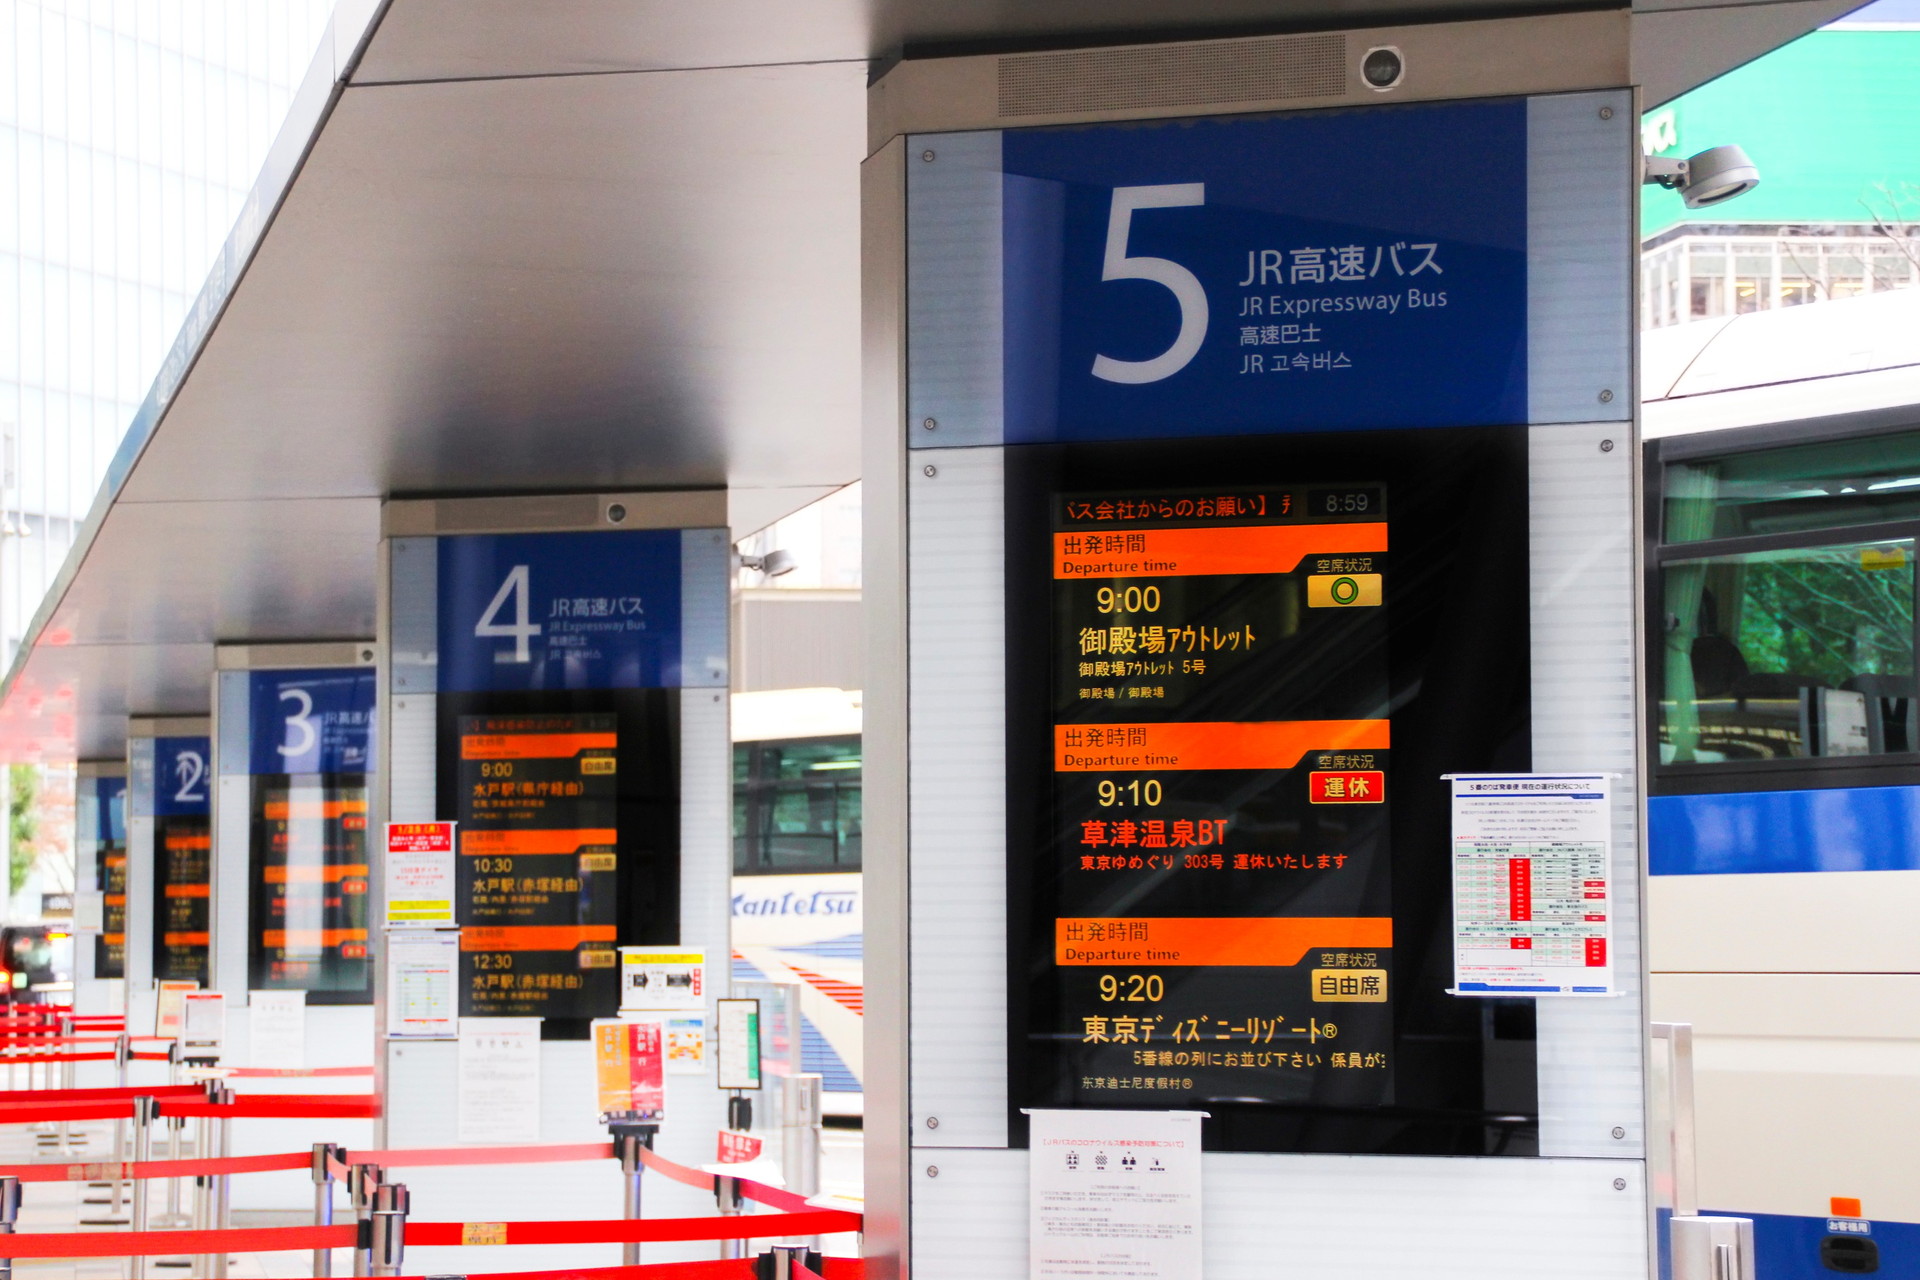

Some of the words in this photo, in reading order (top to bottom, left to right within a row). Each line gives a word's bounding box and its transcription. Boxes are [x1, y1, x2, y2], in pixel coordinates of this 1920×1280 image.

[1239, 242, 1444, 287] JR高速バス
[1092, 182, 1209, 384] 5
[1239, 297, 1263, 317] JR
[1270, 293, 1401, 317] Expressway
[1408, 288, 1447, 309] Bus
[1239, 323, 1322, 347] 高速巴士
[1239, 356, 1264, 375] JR
[1270, 352, 1352, 372] 고속버스
[1326, 494, 1369, 512] 8:59
[1063, 534, 1146, 556] 出発時間
[1063, 561, 1139, 575] Departure
[1143, 559, 1177, 572] time
[1317, 558, 1372, 574] 空席状況
[549, 597, 644, 617] JR高速バス
[1097, 586, 1161, 614] 9:00
[475, 564, 542, 663] 4
[1183, 659, 1206, 675] 5号
[277, 688, 316, 757] 3
[1065, 728, 1147, 748] 出発時間
[481, 762, 513, 777] 9:00
[1064, 754, 1140, 769] Departure
[1145, 753, 1179, 766] time
[1318, 755, 1375, 770] 空席状況
[175, 752, 204, 801] 2
[1098, 779, 1162, 807] 9:10
[1324, 778, 1370, 798] 運休
[1080, 819, 1229, 848] 草津温泉BT
[473, 858, 513, 873] 10:30
[1080, 855, 1174, 871] 東京ゆめぐり
[1184, 854, 1225, 870] 303号
[1233, 853, 1348, 870] 運休いたします
[1066, 922, 1149, 942] 出発時間
[473, 954, 513, 969] 12:30
[1065, 948, 1142, 962] Departure
[1146, 948, 1181, 961] time
[1321, 953, 1377, 968] 空席状況
[1099, 974, 1164, 1002] 9:20
[1320, 976, 1380, 996] 自由席
[1134, 1051, 1322, 1068] 5番線の列にお並び下さい
[1330, 1052, 1386, 1068] 係員が
